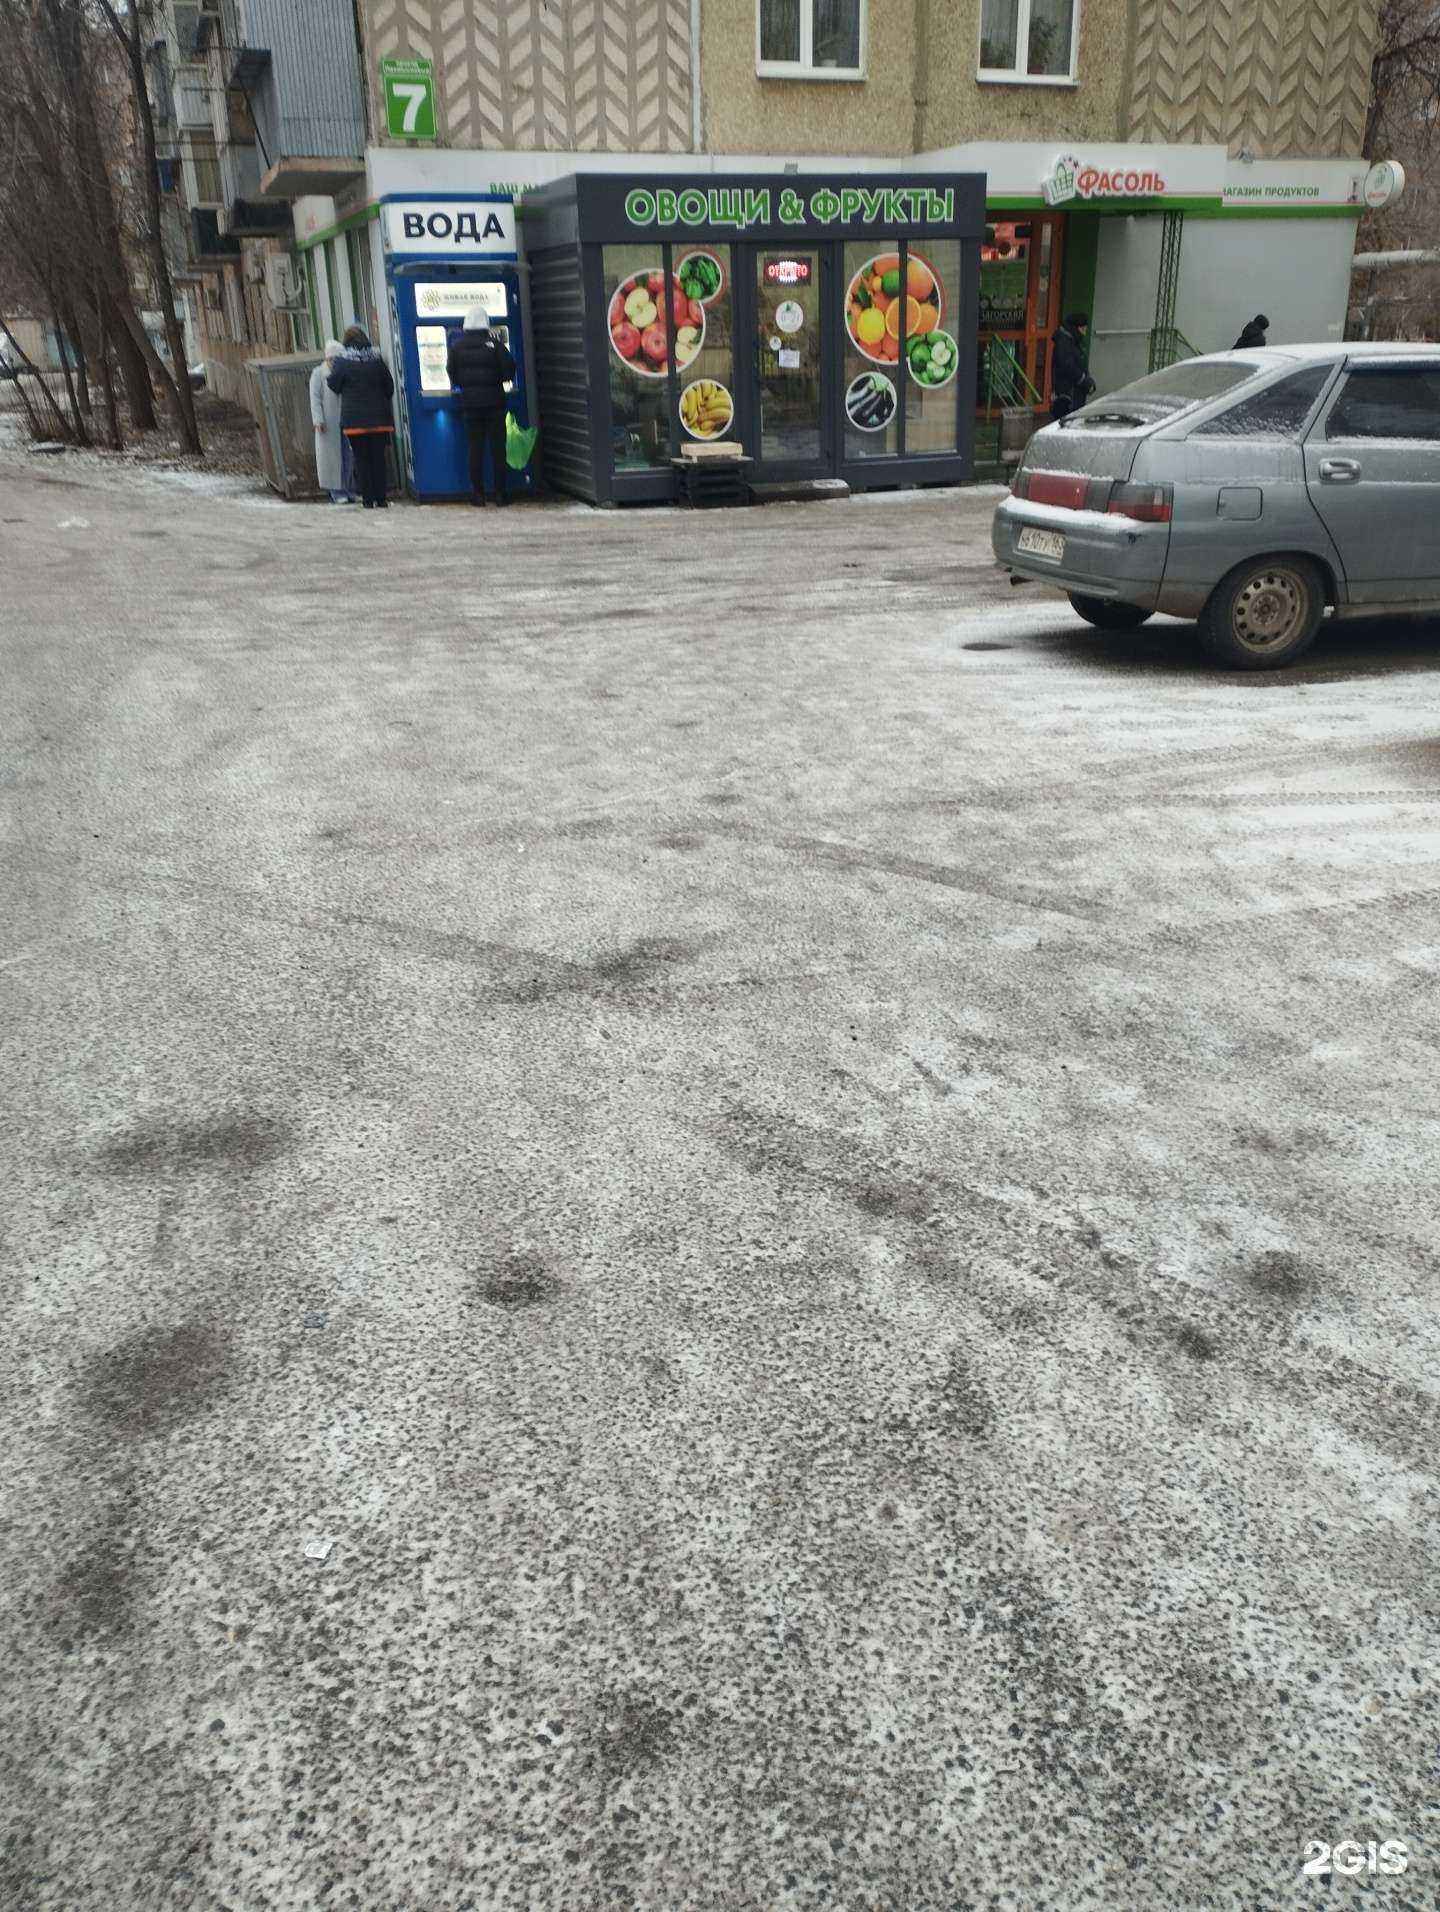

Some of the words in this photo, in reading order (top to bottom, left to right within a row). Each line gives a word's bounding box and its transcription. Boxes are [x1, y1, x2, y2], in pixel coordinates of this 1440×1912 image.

[392, 83, 427, 133] 7
[1077, 166, 1165, 195] ФАСОЛЬ
[1264, 187, 1320, 198] ПРОДУКТОВ
[625, 188, 770, 229] ОВОЩИ
[778, 188, 806, 224] &
[810, 187, 955, 224] ФРУКТЫ
[403, 212, 506, 243] ВОДА
